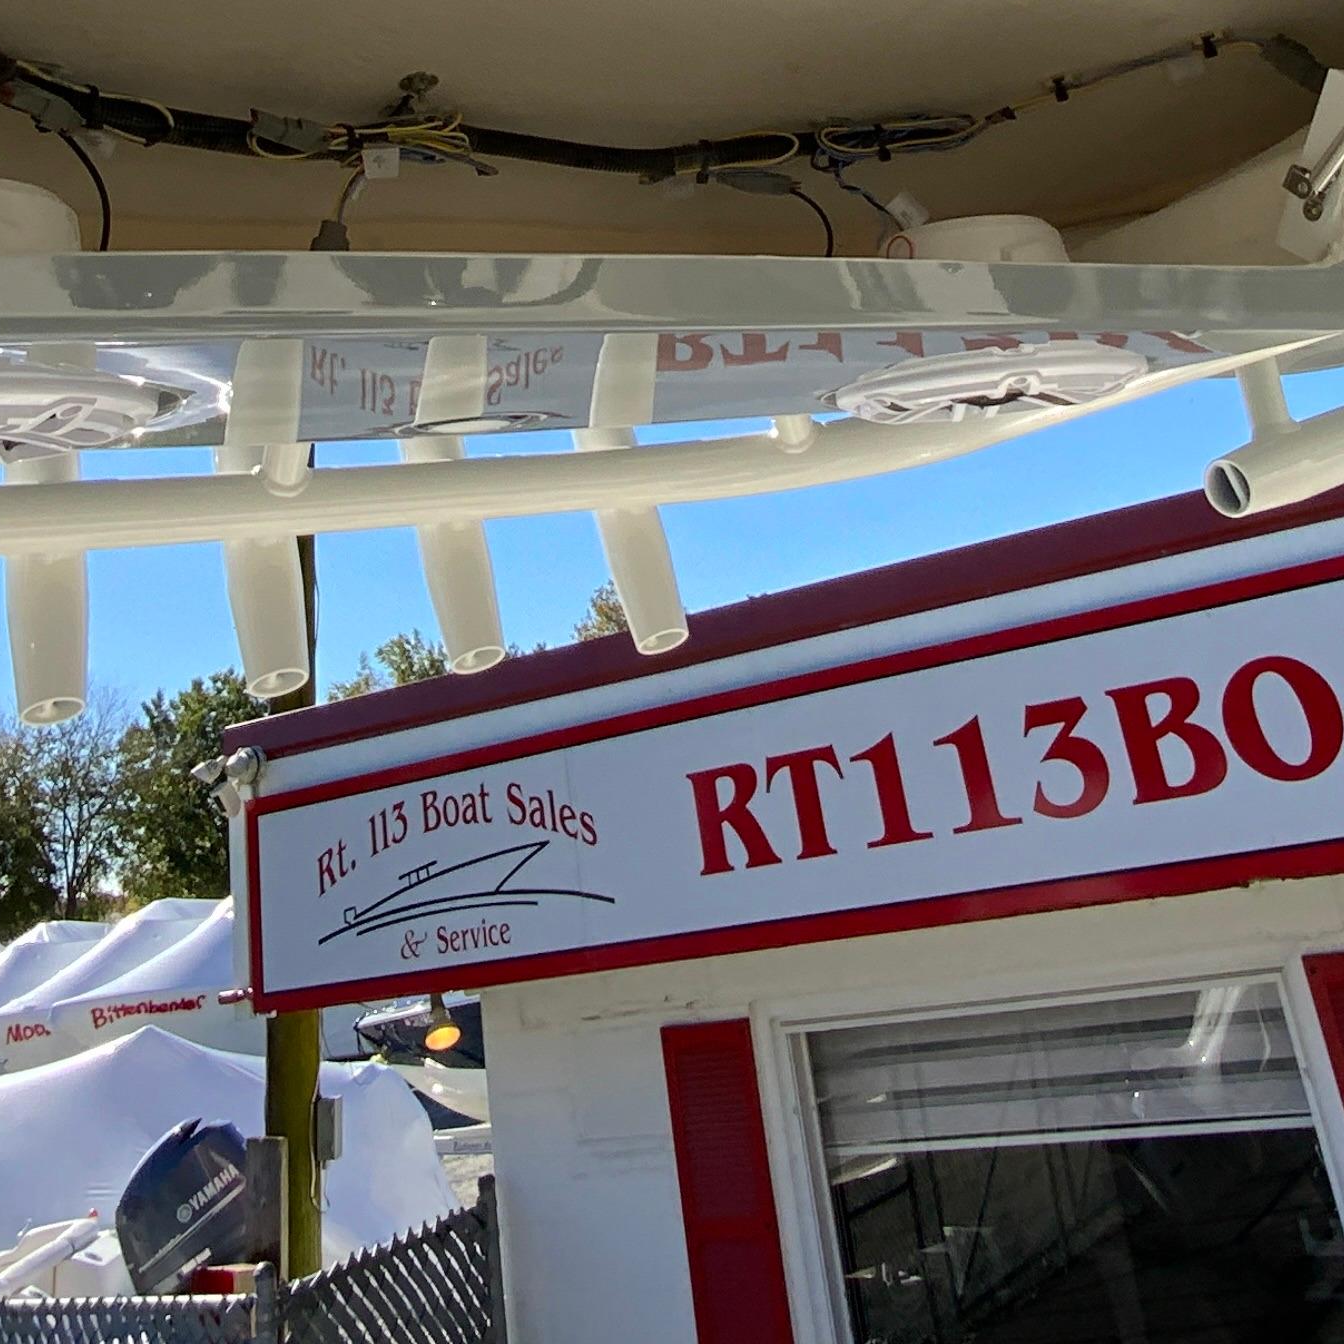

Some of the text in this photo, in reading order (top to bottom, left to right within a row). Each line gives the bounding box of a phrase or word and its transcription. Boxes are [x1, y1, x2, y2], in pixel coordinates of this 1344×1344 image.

[317, 782, 598, 897] Rt. 113 Boat Sales
[399, 918, 512, 960] & Service
[188, 1163, 240, 1211] YAMAHA
